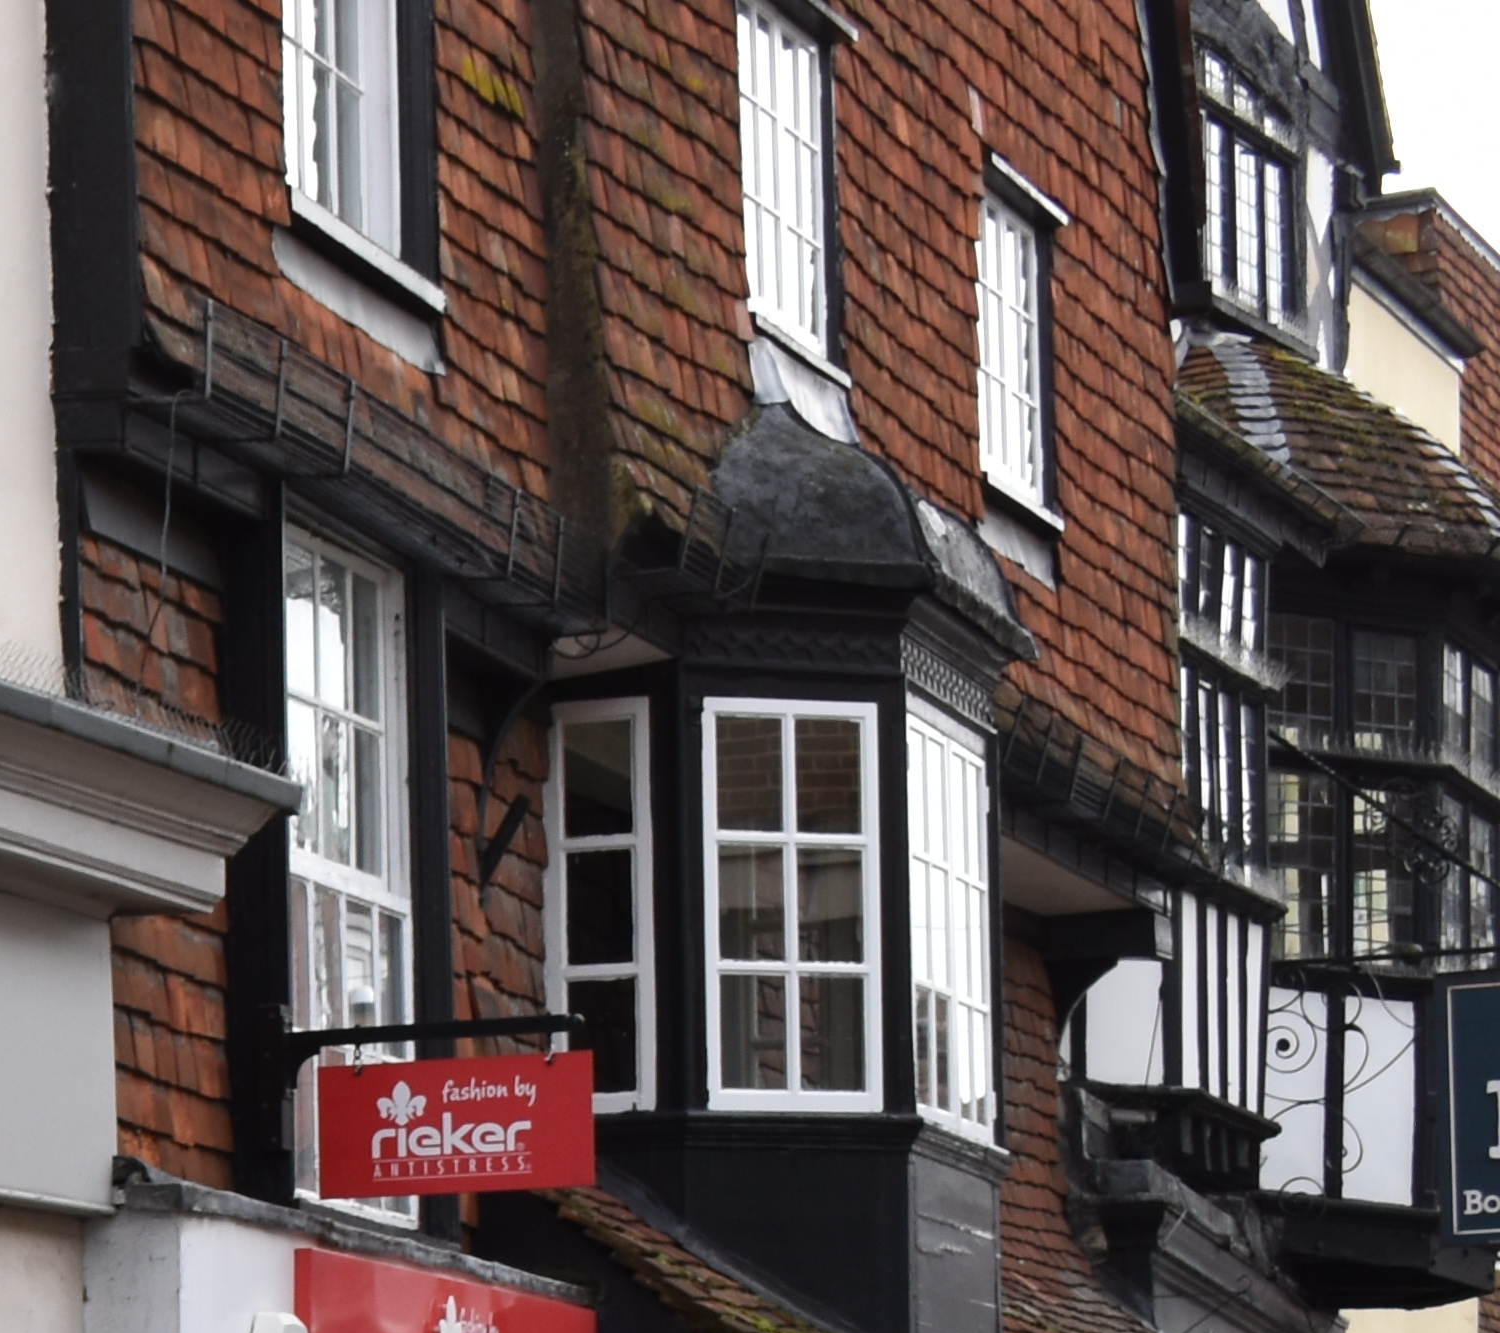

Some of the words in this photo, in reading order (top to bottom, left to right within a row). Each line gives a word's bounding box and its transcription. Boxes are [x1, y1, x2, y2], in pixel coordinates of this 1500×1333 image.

[442, 1079, 509, 1104] fashion
[514, 1075, 537, 1107] by
[371, 1112, 532, 1159] rieker
[373, 1155, 527, 1179] ANTISTRESS
